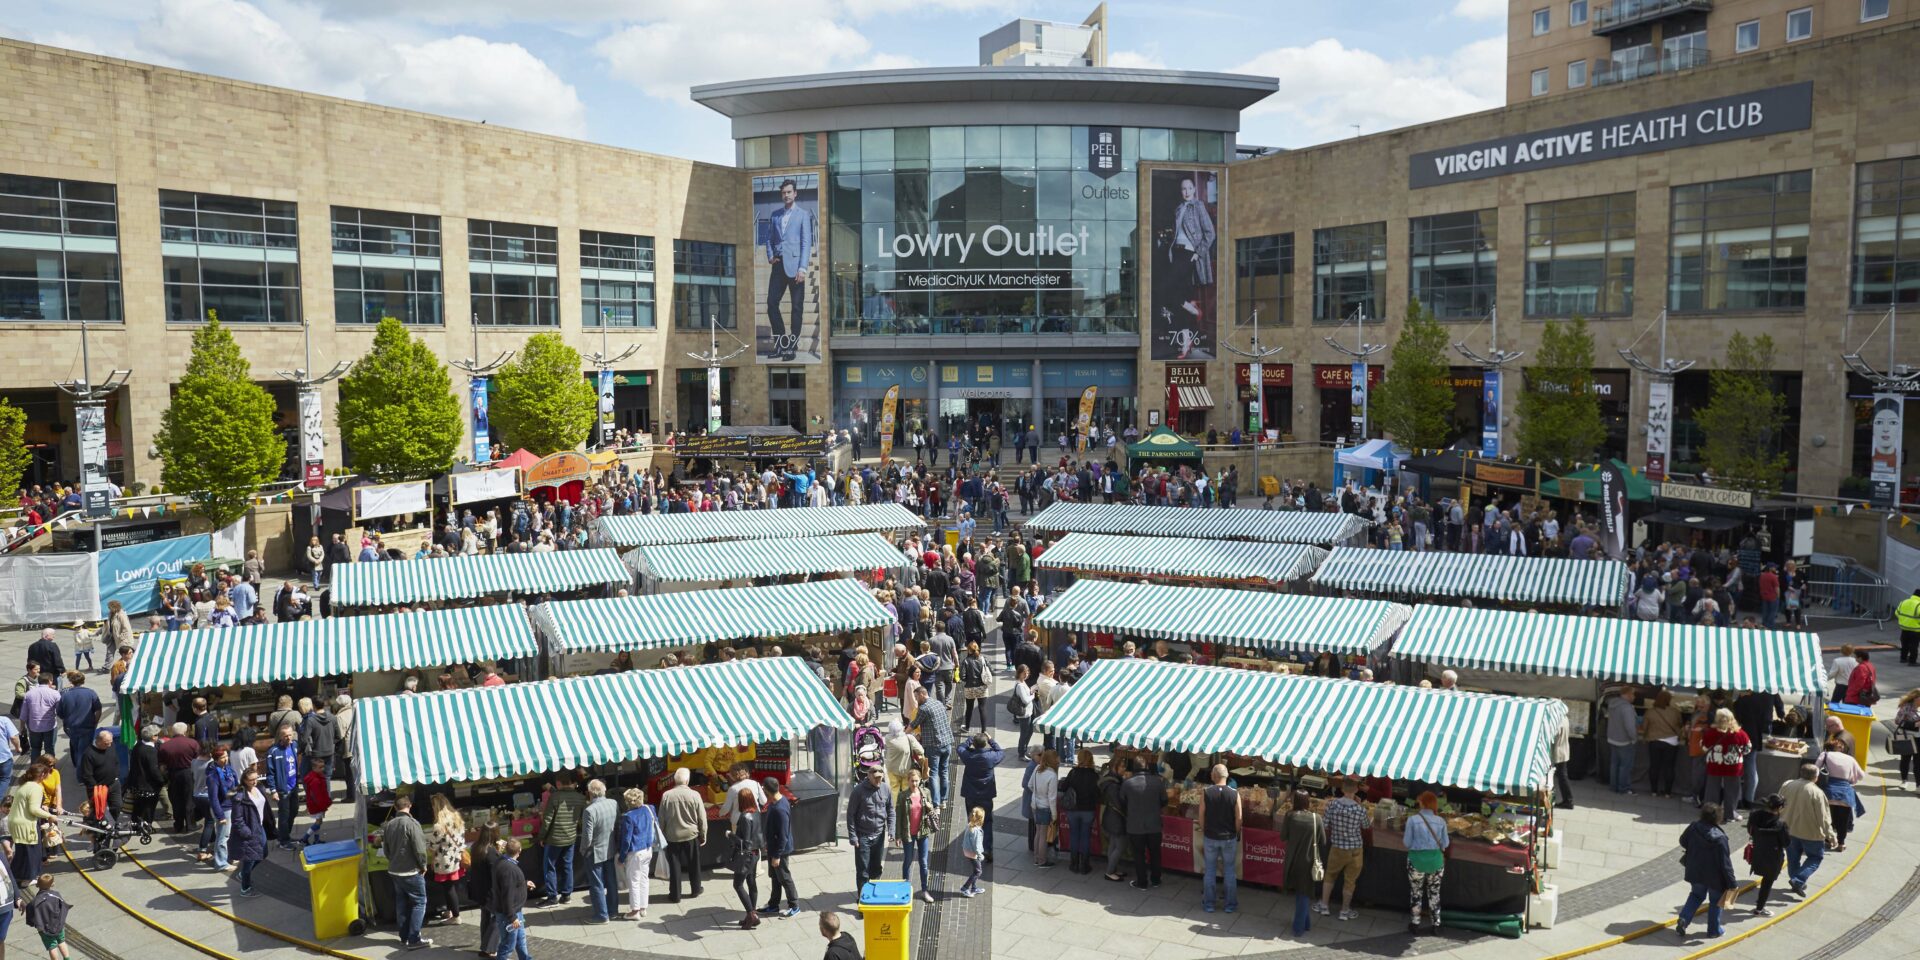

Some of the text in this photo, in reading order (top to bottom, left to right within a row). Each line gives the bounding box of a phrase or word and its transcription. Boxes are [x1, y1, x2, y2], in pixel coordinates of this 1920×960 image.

[1435, 102, 1764, 176] VIRGIN ACTIVE HEALTH CLUB
[1091, 143, 1119, 156] PEEL
[1082, 185, 1130, 200] Outlets
[878, 224, 1090, 264] Lowry Outlet
[908, 274, 1061, 288] MediaCityUK Manchester
[771, 334, 804, 349] 70%
[1168, 330, 1201, 346] 70%
[1171, 367, 1200, 375] BELLA
[1262, 369, 1285, 378] ROUGE
[1321, 368, 1342, 380] CAFÉ
[1170, 376, 1201, 384] ITALIA
[1454, 379, 1483, 387] BUFFET
[958, 388, 1012, 398] Welcome
[1664, 484, 1692, 498] FRESHLY
[1694, 487, 1714, 500] MADE
[115, 565, 155, 583] Lowry
[1245, 854, 1284, 864] cranberr
